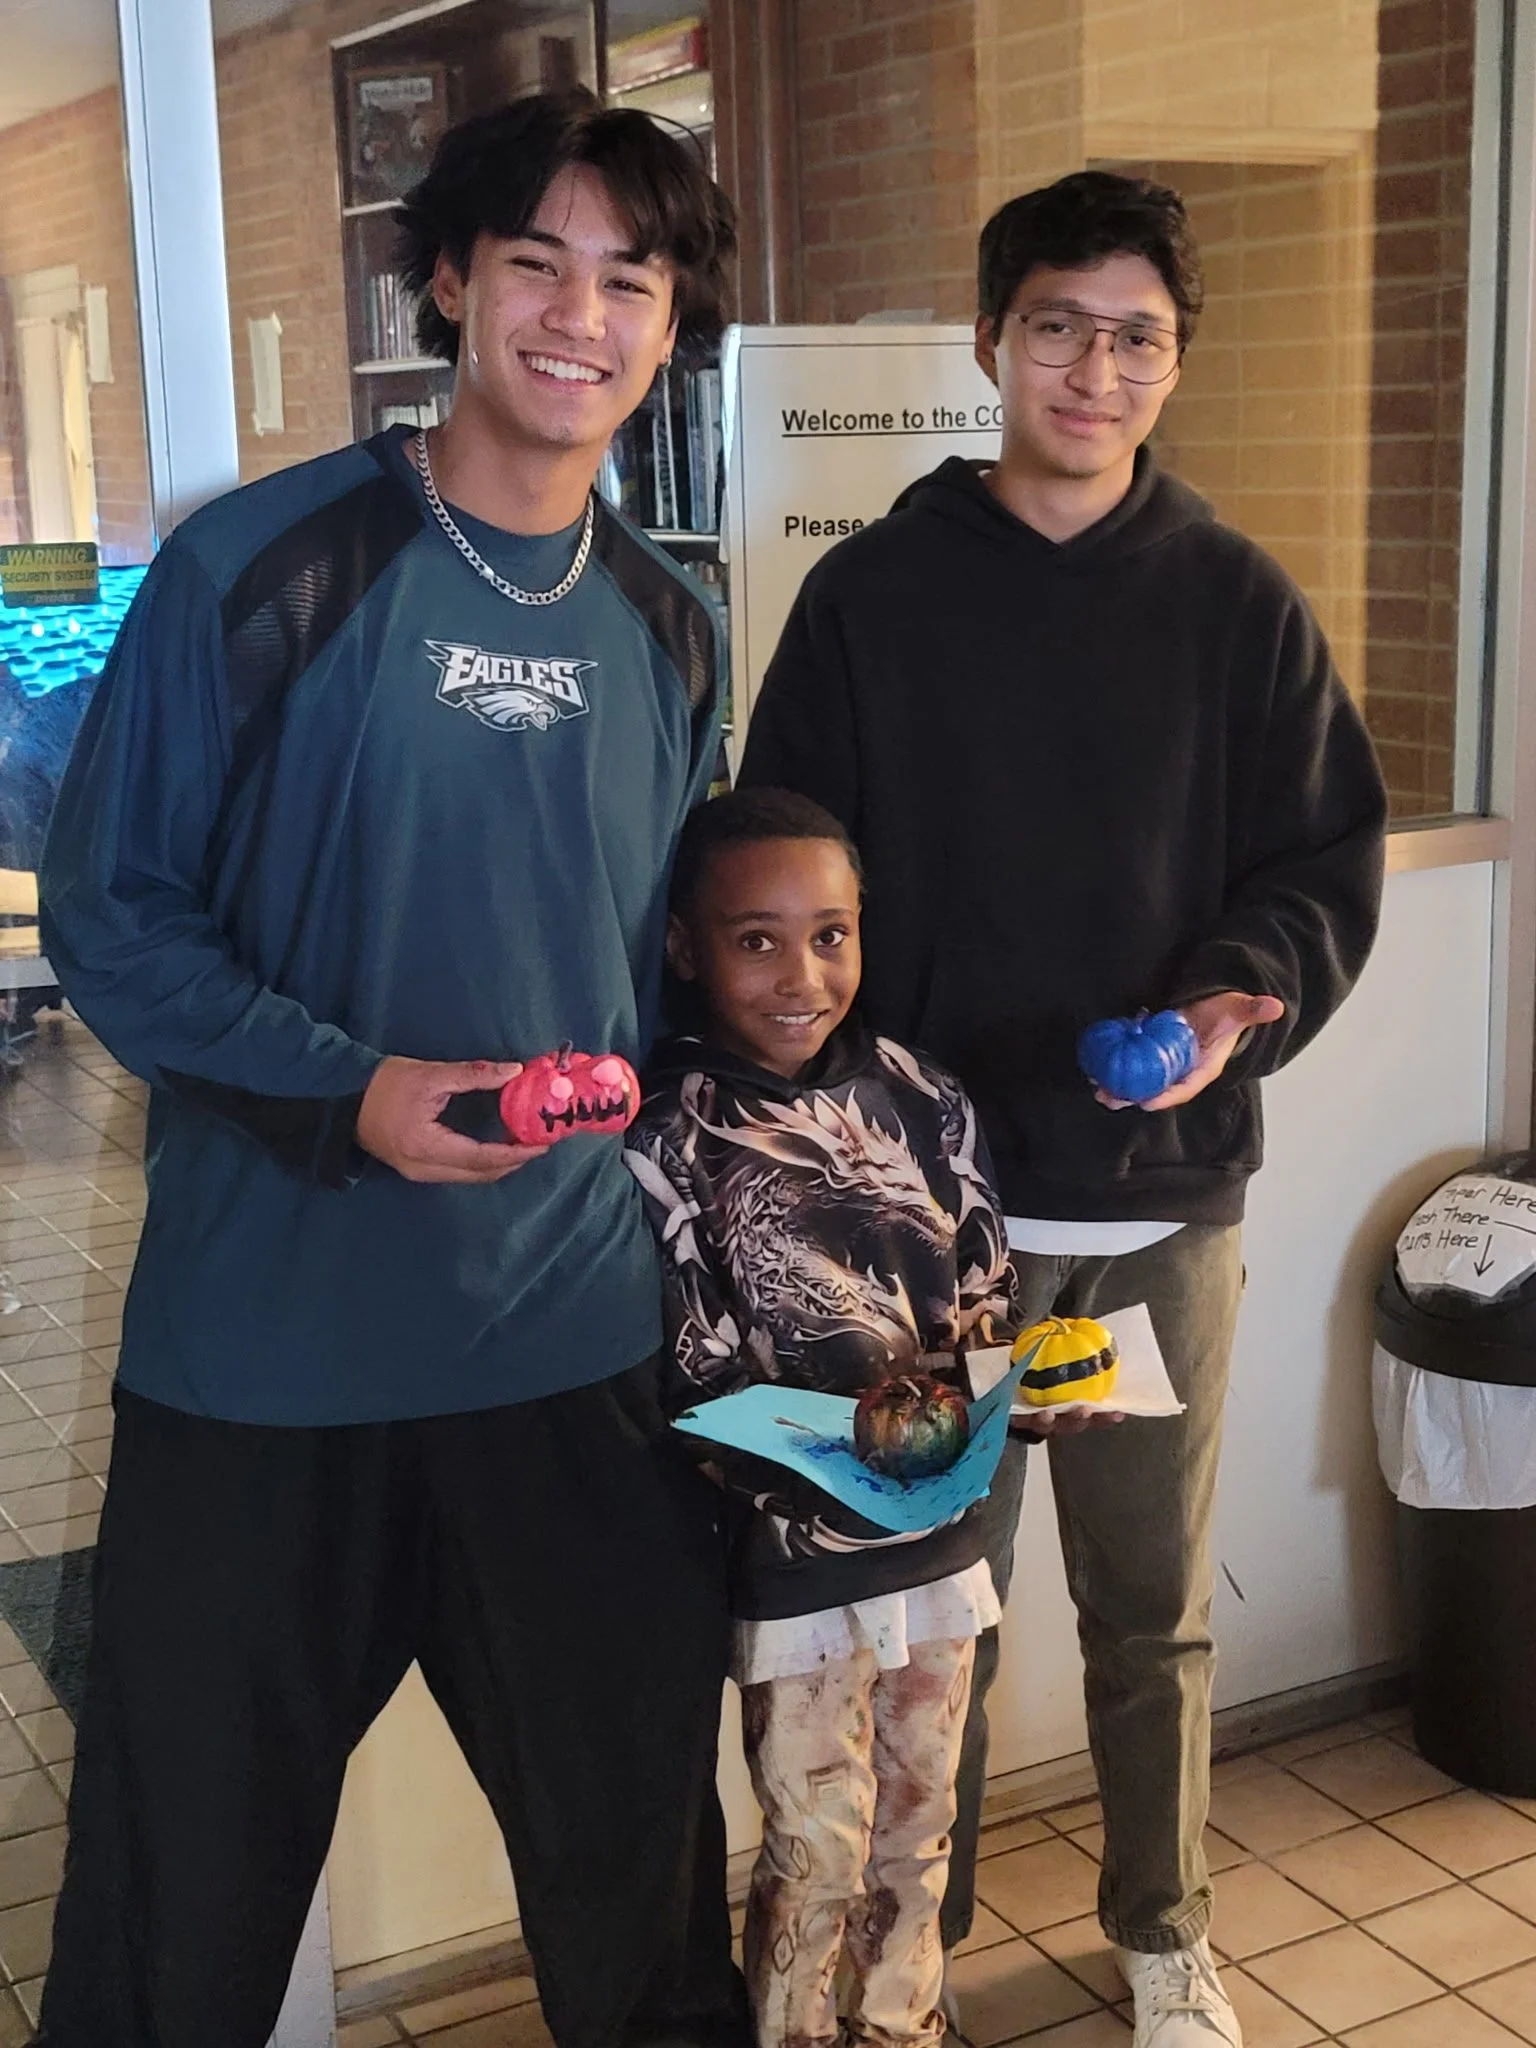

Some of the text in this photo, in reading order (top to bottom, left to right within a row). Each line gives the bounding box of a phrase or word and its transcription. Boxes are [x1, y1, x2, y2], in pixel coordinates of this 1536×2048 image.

[782, 409, 894, 432] Welcome
[902, 408, 924, 429] to
[932, 406, 967, 428] the
[784, 516, 864, 538] Please
[7, 548, 87, 567] WARNING
[2, 571, 50, 583] SECURITY
[442, 646, 583, 707] EAGLES
[1489, 1186, 1536, 1214] Here
[1443, 1205, 1490, 1226] There
[1435, 1229, 1479, 1249] Here
